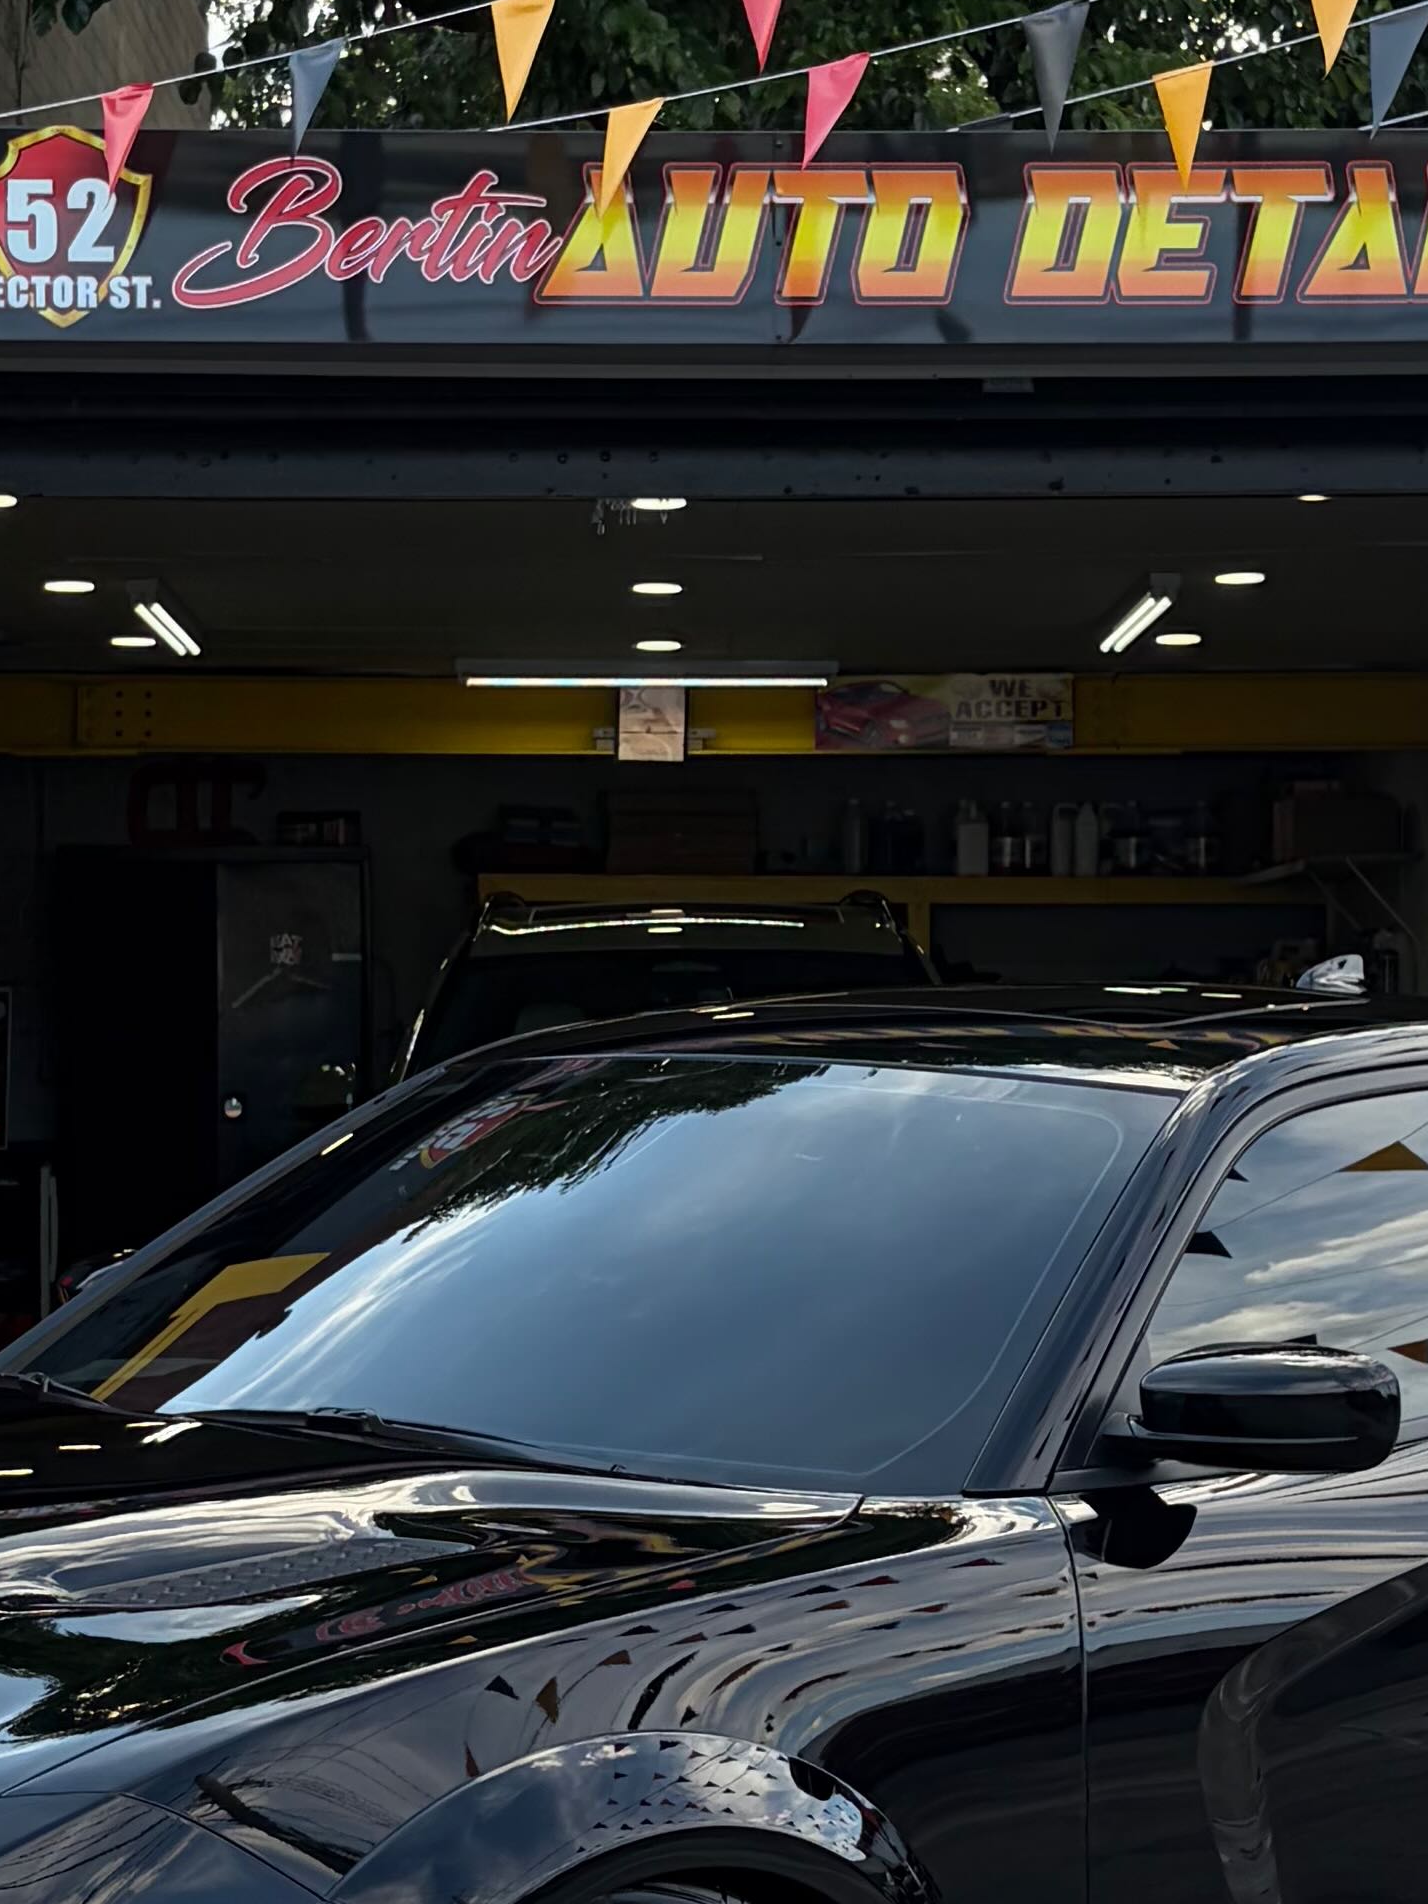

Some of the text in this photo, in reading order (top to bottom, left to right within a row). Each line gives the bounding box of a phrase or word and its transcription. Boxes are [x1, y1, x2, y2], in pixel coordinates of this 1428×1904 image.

[5, 178, 115, 264] 52
[172, 155, 563, 309] Bertin
[534, 163, 970, 305] AUTO
[109, 274, 161, 309] ST.
[988, 679, 1033, 698] WE
[955, 699, 1065, 721] ACCEPT
